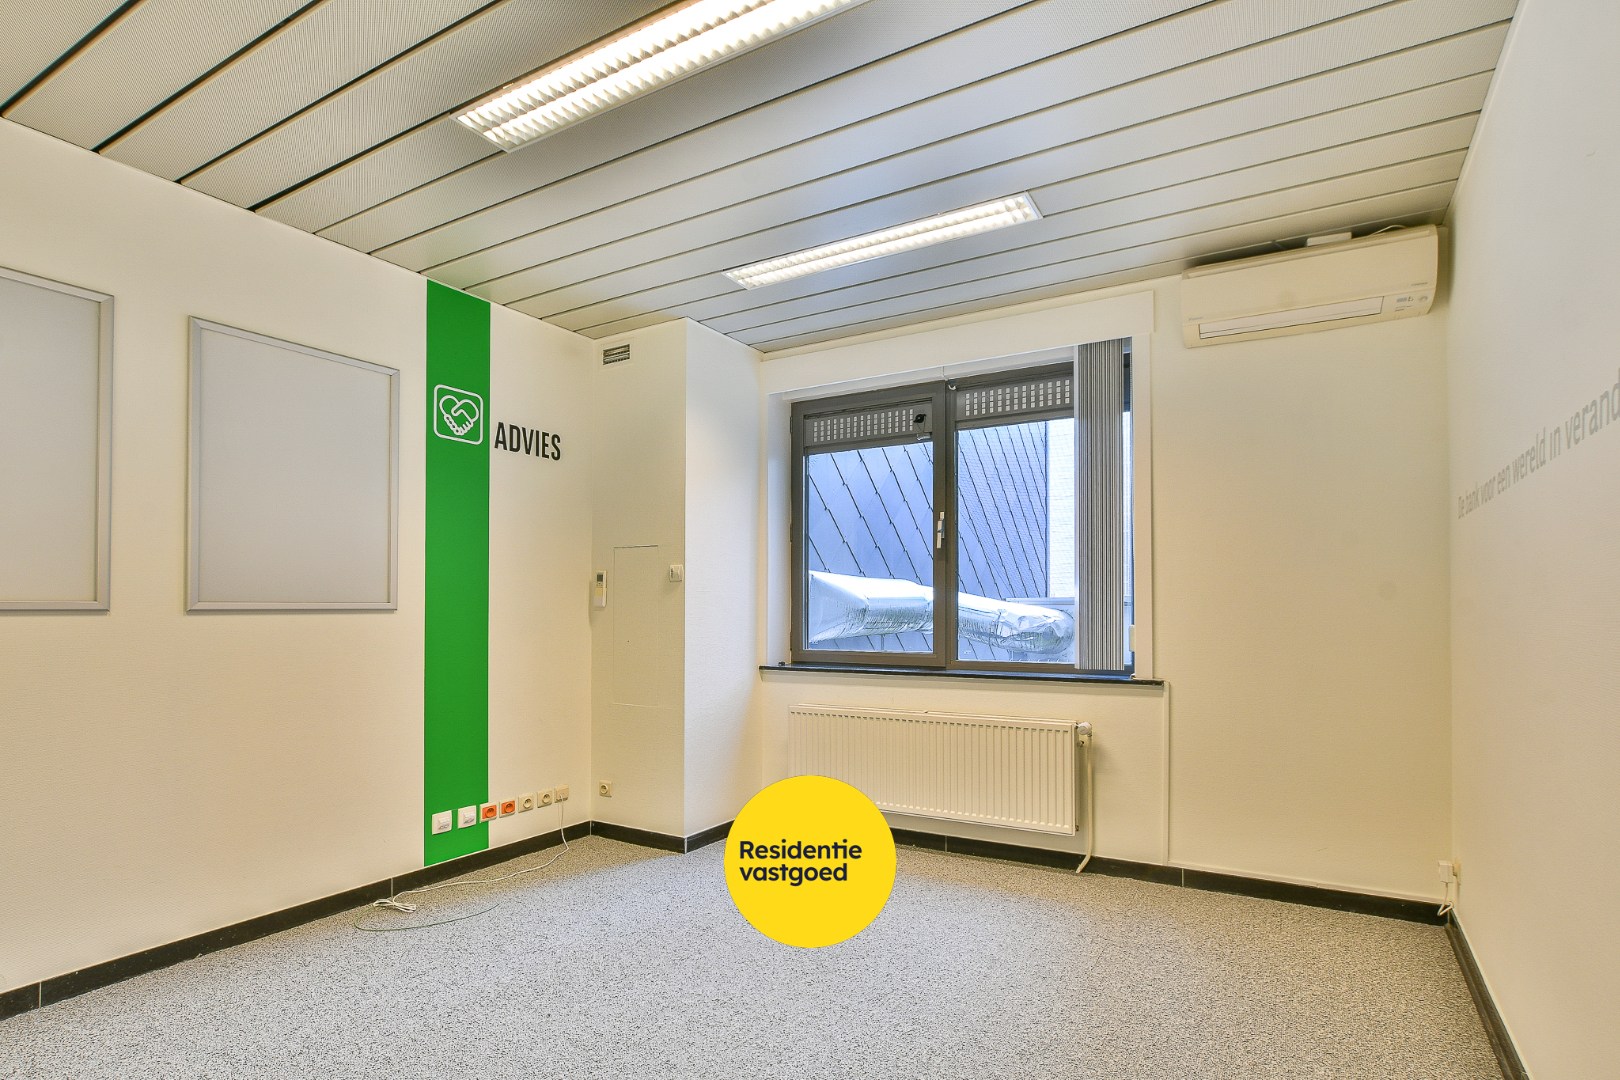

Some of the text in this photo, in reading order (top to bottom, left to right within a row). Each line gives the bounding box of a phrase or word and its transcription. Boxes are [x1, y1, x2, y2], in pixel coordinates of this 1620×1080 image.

[494, 421, 561, 461] ADVIES
[1480, 475, 1496, 504] voor
[1497, 464, 1511, 494] een
[1512, 426, 1546, 484] wereld
[1549, 426, 1561, 461] in
